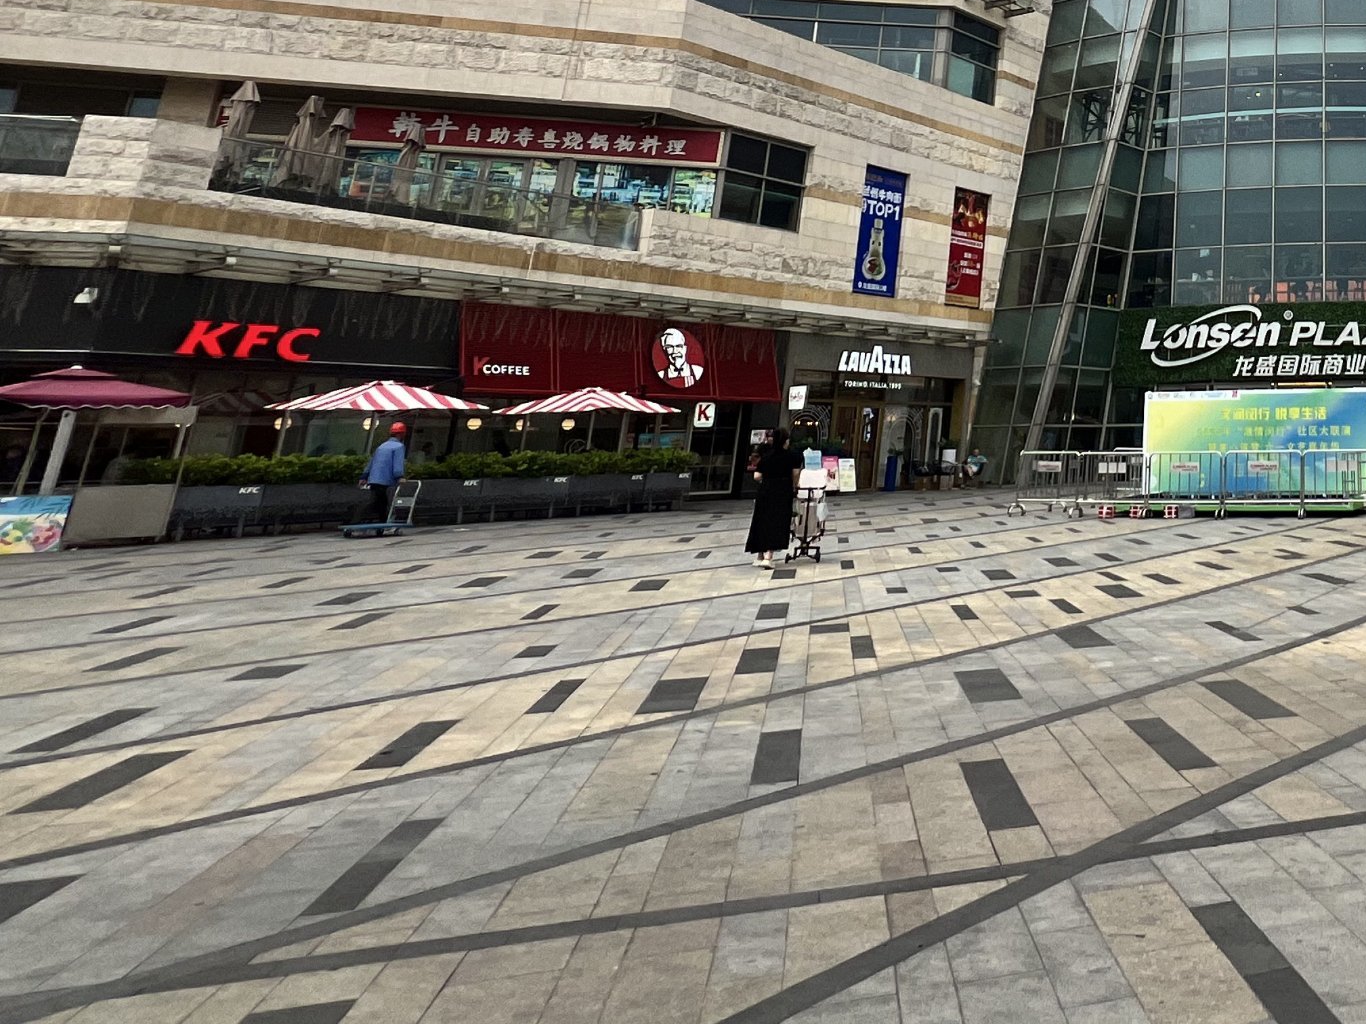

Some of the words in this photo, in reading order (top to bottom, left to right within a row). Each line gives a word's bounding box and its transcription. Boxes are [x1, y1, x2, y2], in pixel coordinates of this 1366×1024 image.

[175, 320, 321, 362] KFC
[838, 345, 911, 375] LAVAZZA
[698, 404, 712, 422] K
[238, 486, 261, 494] KFC
[463, 479, 479, 487] KFC
